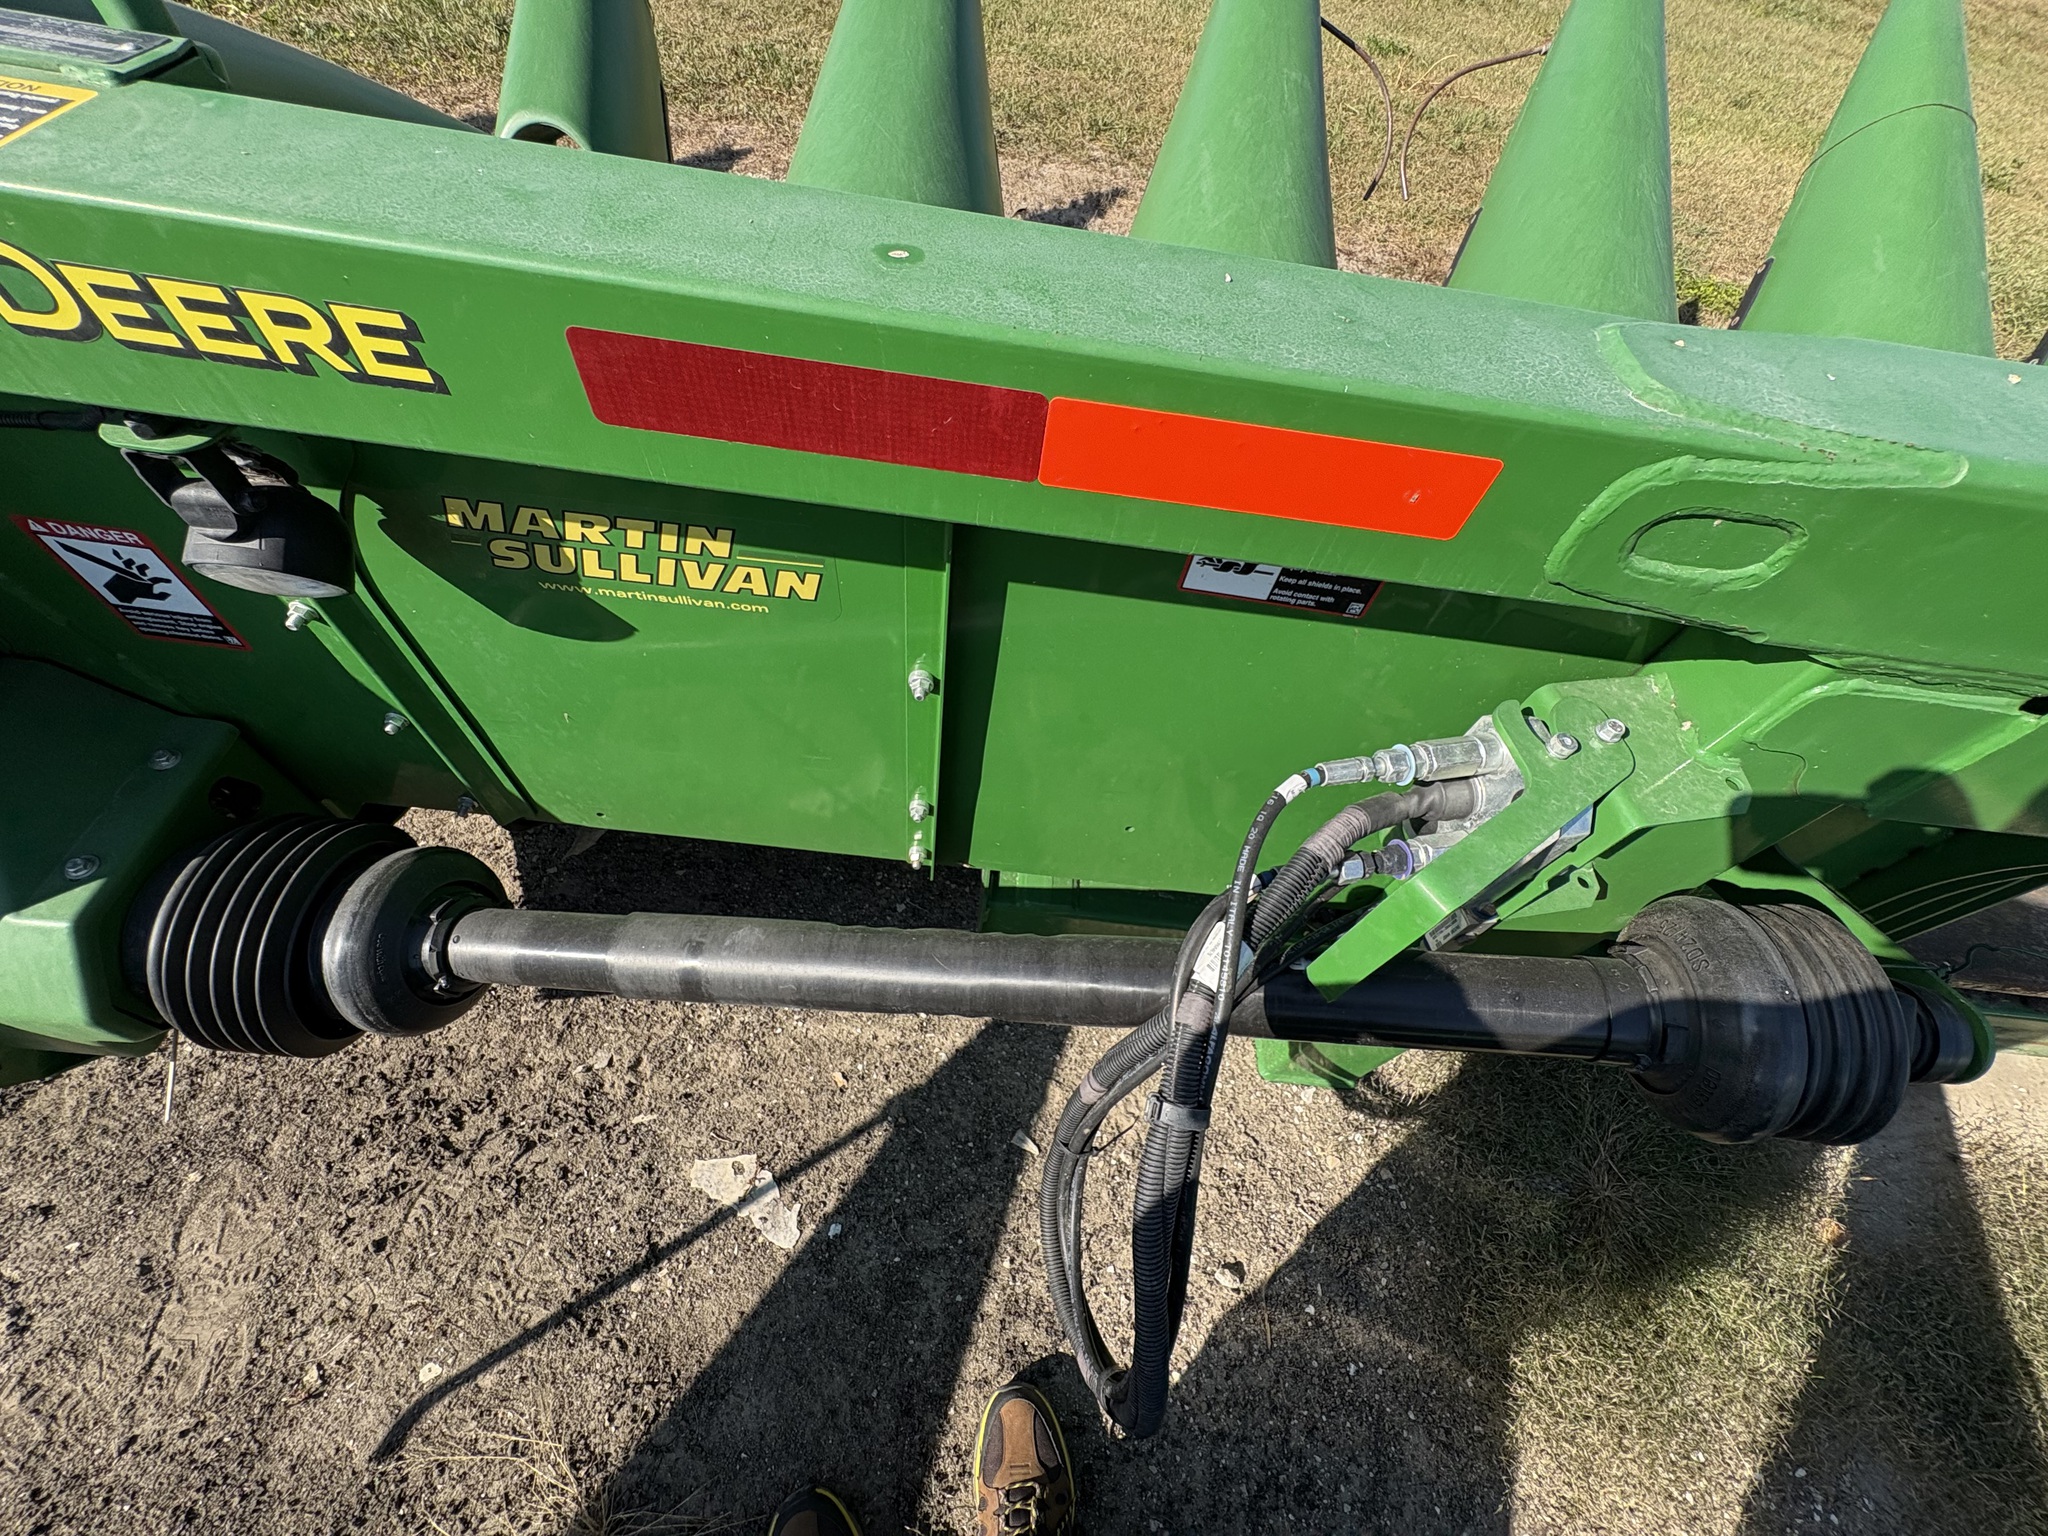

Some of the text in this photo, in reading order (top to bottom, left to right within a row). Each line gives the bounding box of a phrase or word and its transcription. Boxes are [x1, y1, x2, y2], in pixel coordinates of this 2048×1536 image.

[0, 79, 42, 92] ION
[0, 238, 450, 396] DEERE
[45, 521, 146, 546] DANGER
[441, 496, 735, 560] MARTIN
[487, 537, 823, 602] SULLIVAN
[538, 581, 769, 614] www.martinsullivan.com
[1272, 587, 1335, 603] Avoid contact with
[1279, 575, 1362, 595] Keep all shields in place.
[1269, 594, 1317, 607] rotating parts.
[1248, 826, 1259, 841] 20
[1236, 845, 1252, 873] MADE
[1232, 880, 1242, 894] IN
[1225, 901, 1238, 937] ITALY
